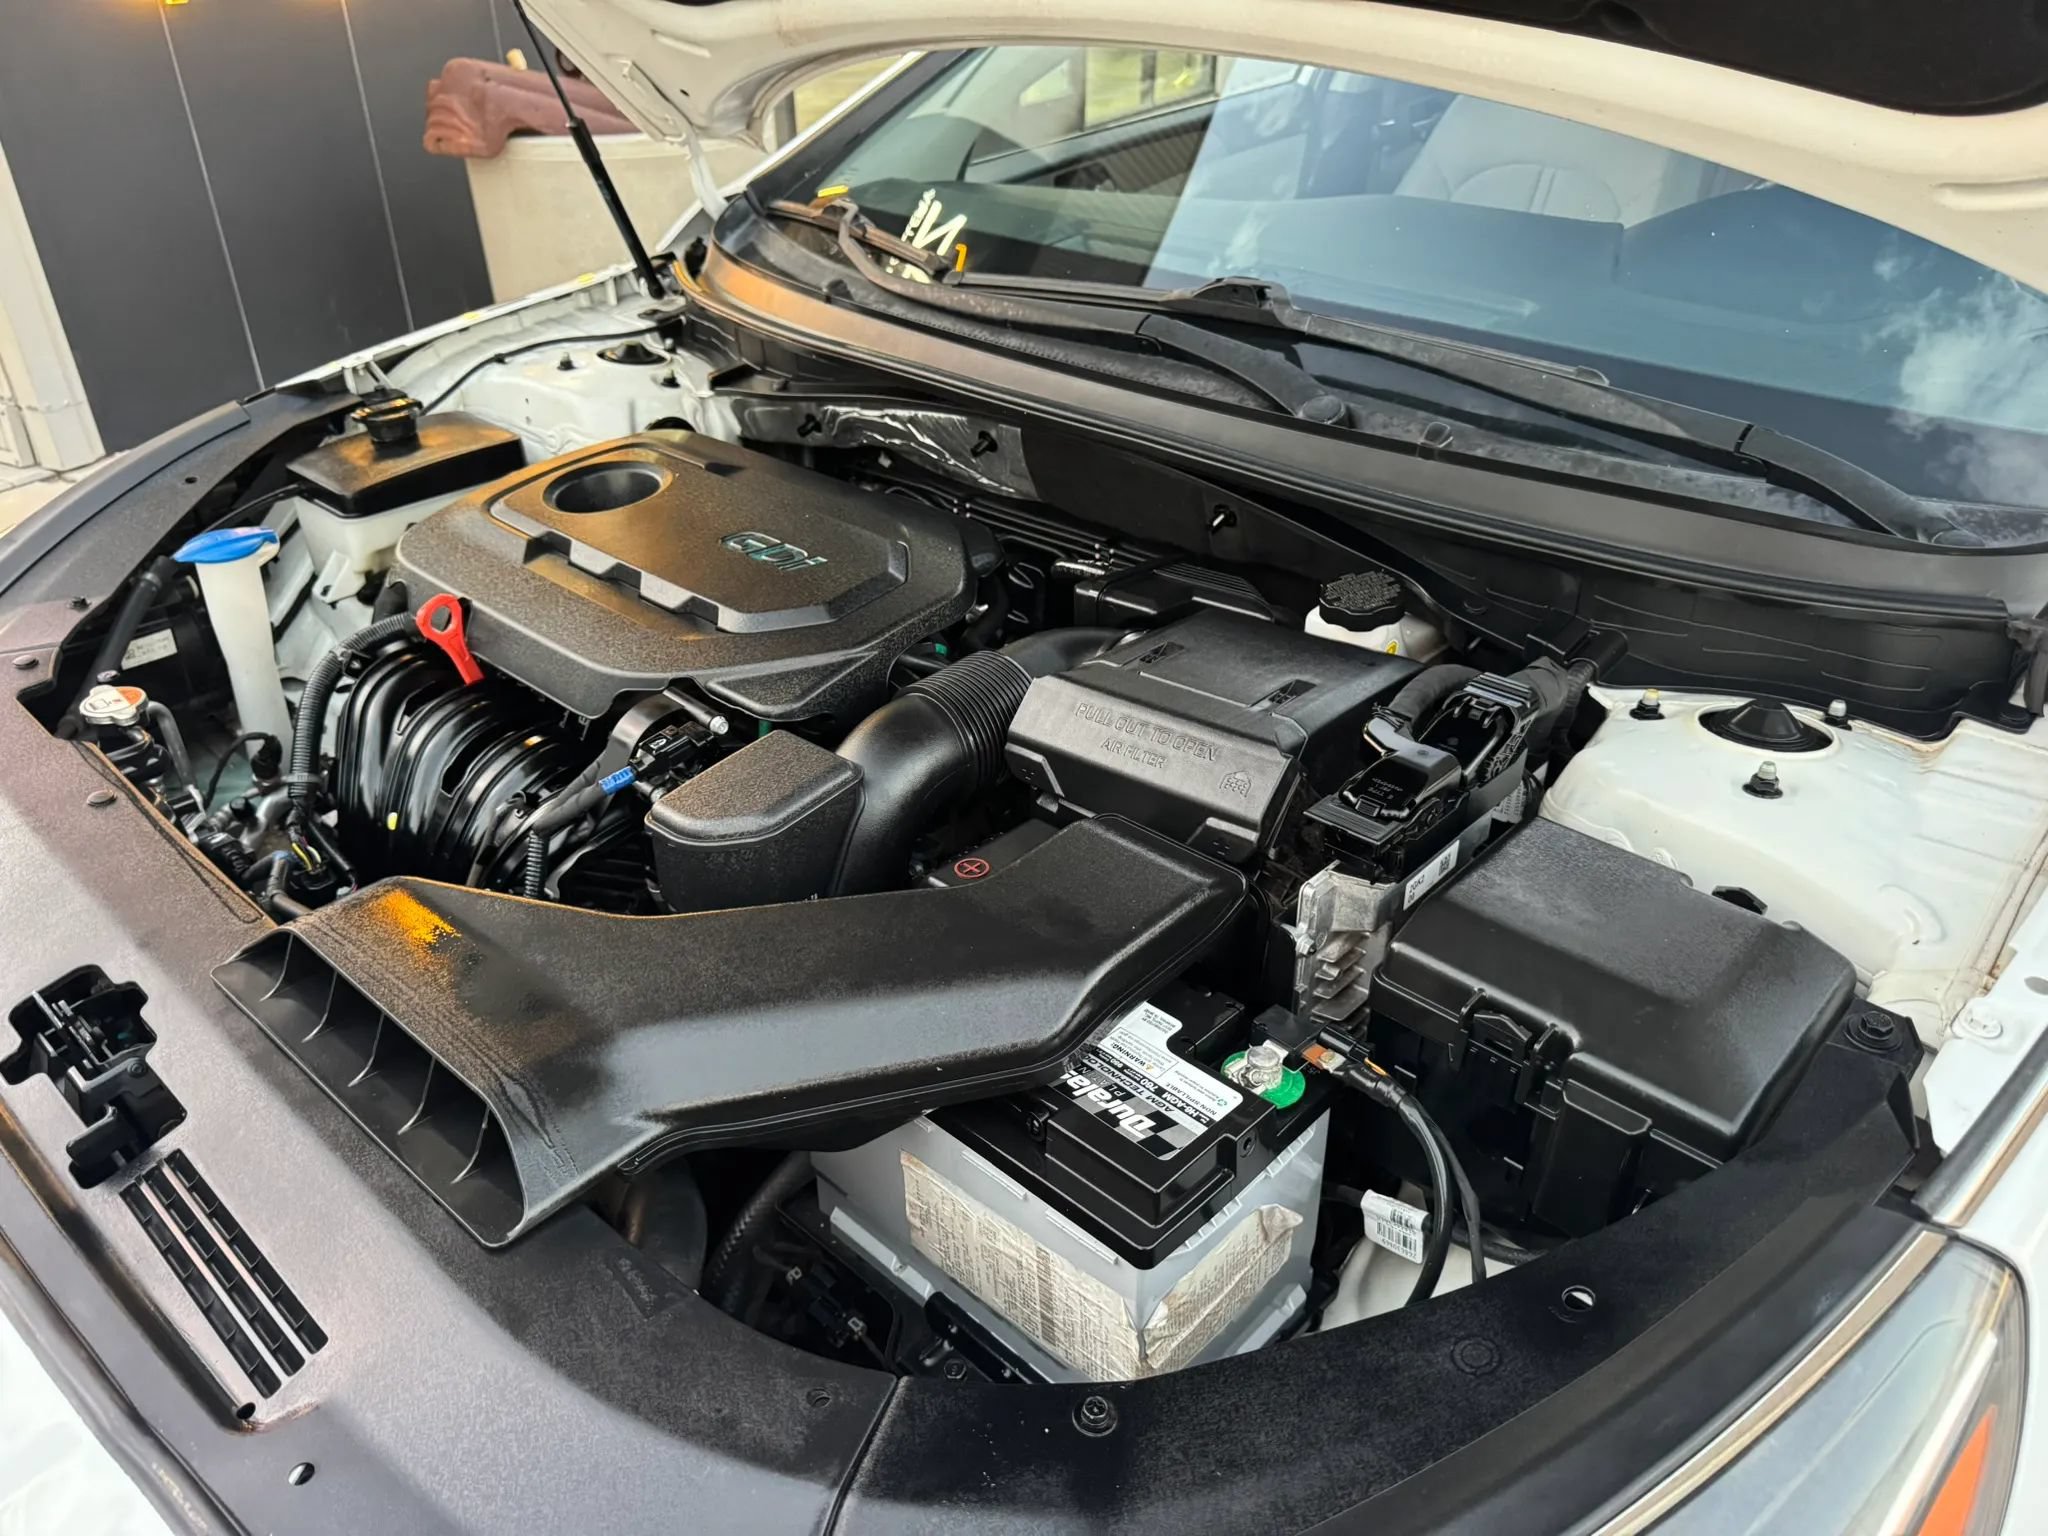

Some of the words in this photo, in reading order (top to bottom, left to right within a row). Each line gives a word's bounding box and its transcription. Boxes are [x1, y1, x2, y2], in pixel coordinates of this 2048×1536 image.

[1075, 702, 1112, 727] PULL
[1114, 716, 1148, 737] OUT
[1150, 727, 1173, 745] TO
[1172, 735, 1219, 761] OPEN
[1101, 737, 1124, 755] AIR
[1123, 744, 1169, 769] FILTER
[1111, 1041, 1147, 1067] WARNING:
[1145, 1093, 1175, 1111] AGM
